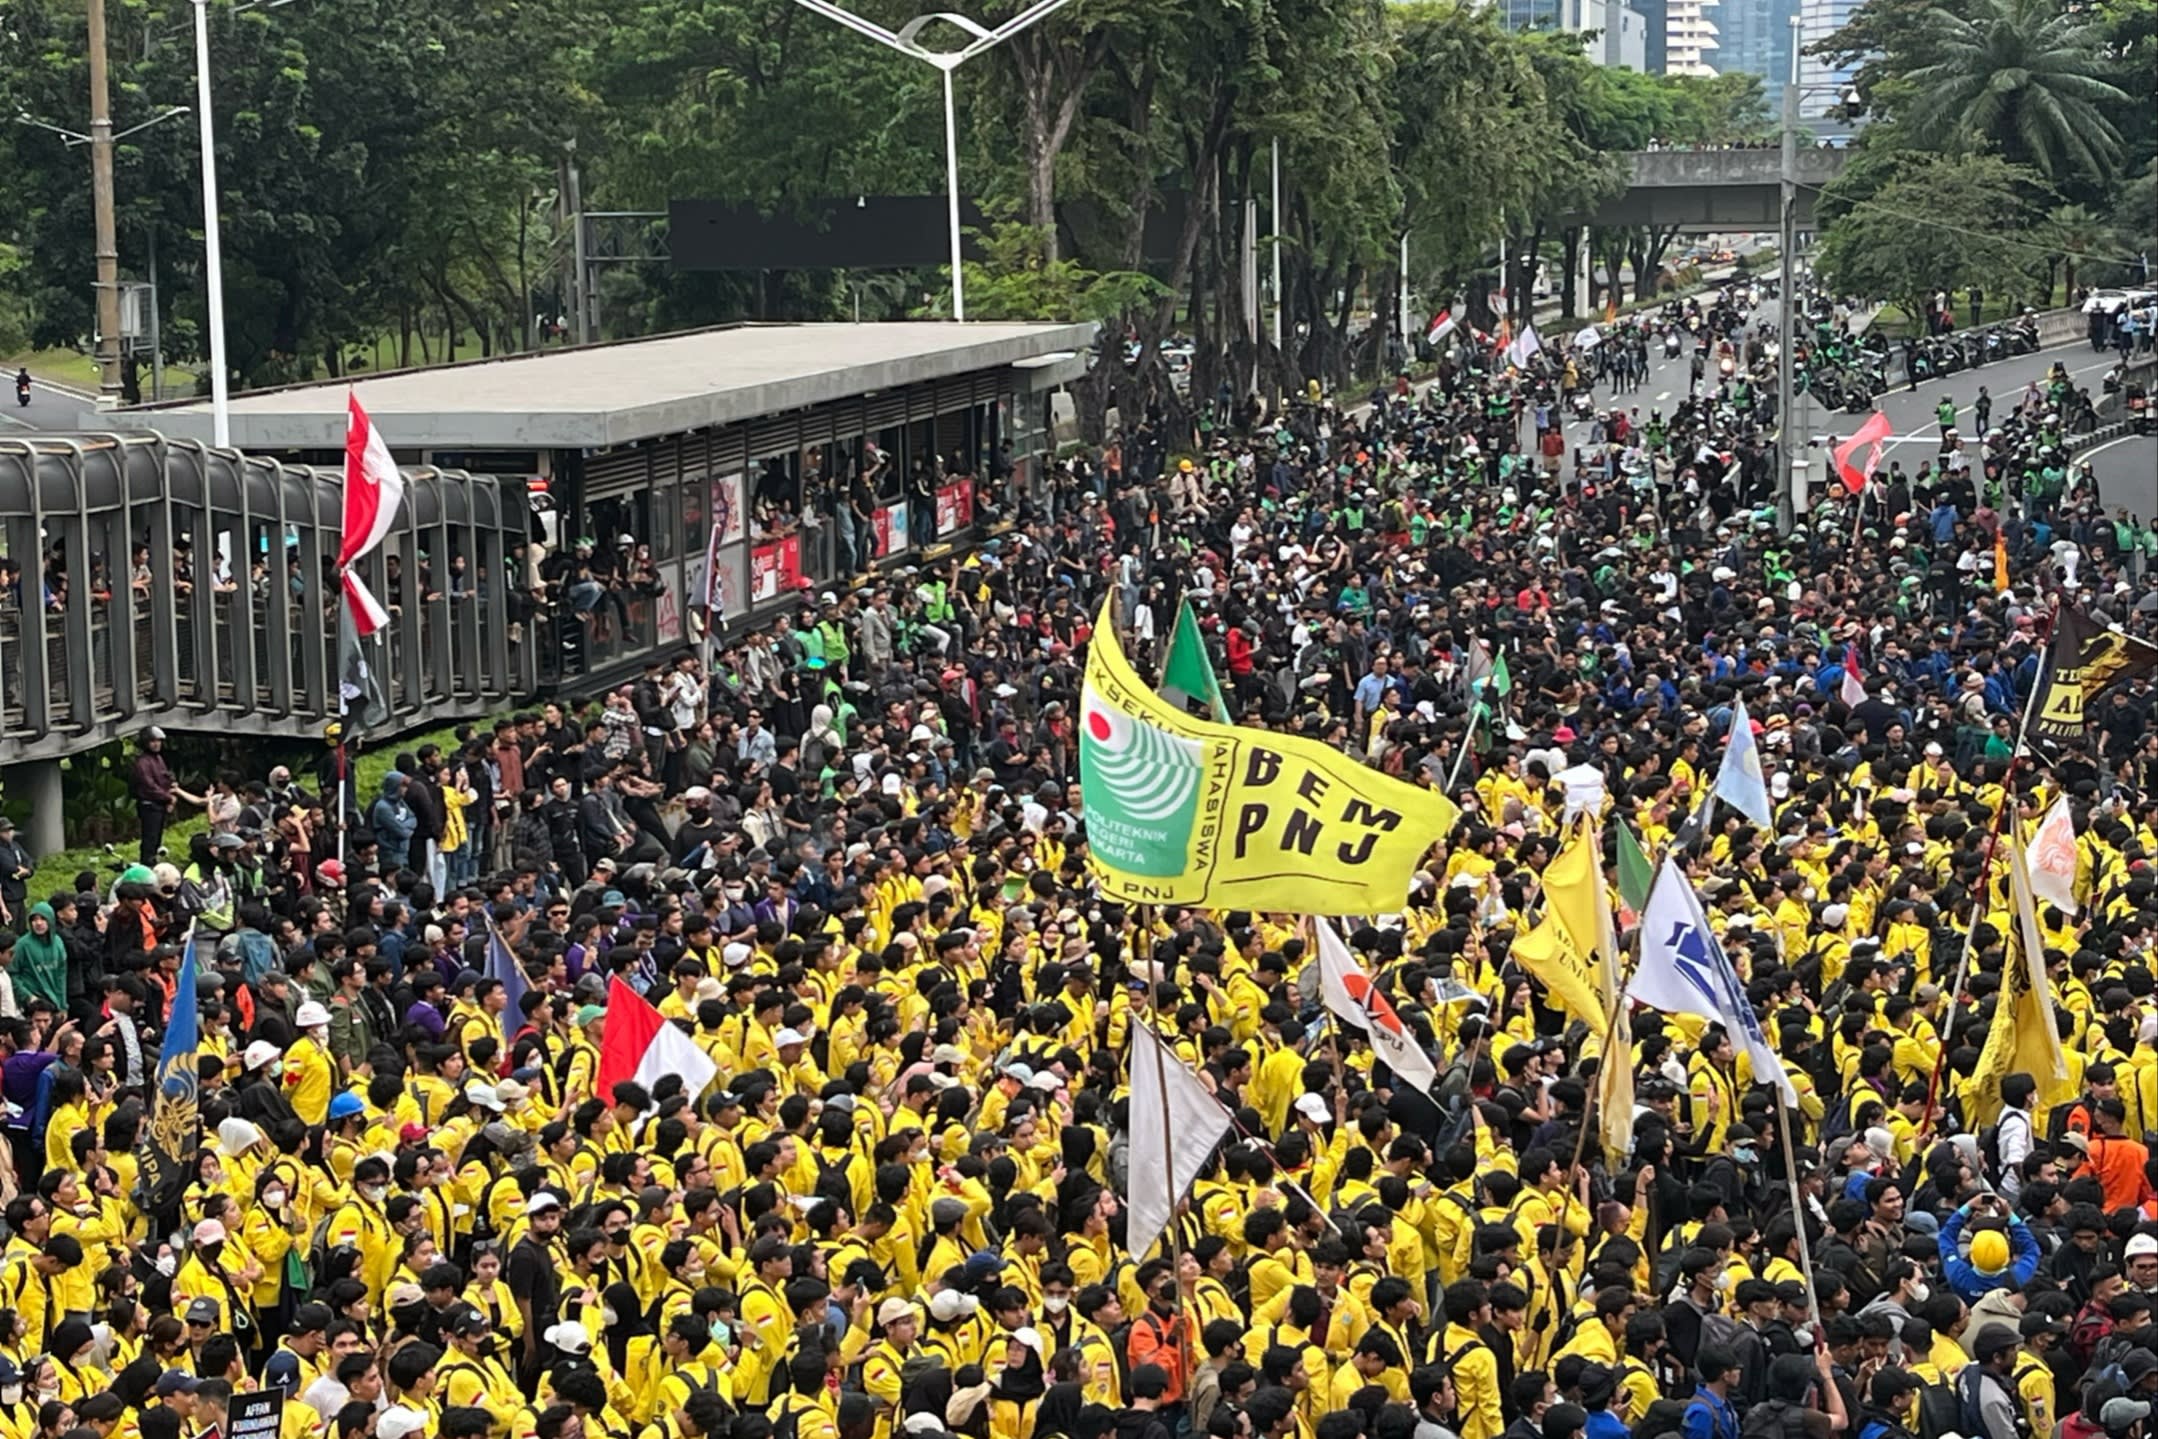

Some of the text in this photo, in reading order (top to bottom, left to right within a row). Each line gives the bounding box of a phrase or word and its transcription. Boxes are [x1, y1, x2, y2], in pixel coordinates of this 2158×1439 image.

[1193, 742, 1228, 871] AHASISWA
[1243, 747, 1403, 832] BEM
[1235, 803, 1379, 865] PNJ
[1123, 882, 1174, 900] PNJ
